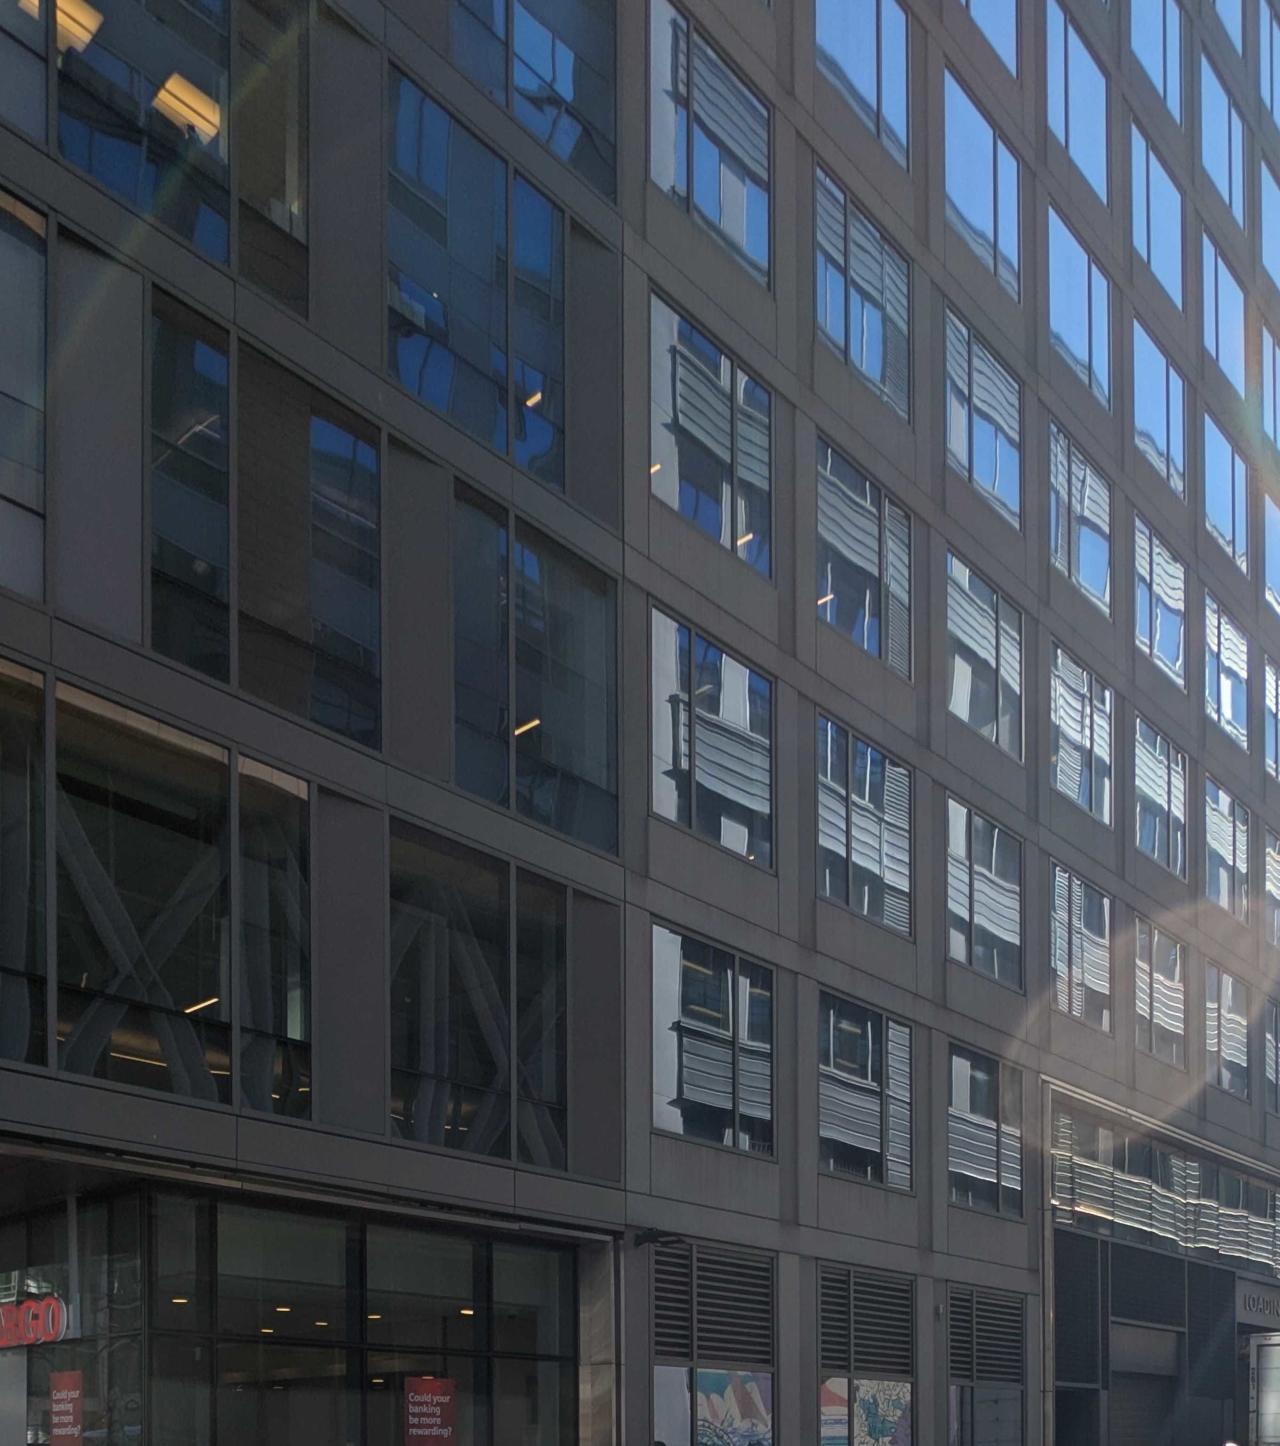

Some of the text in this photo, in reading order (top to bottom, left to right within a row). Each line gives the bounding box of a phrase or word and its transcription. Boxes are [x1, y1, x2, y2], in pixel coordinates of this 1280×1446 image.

[52, 1390, 80, 1401] Could your
[409, 1393, 451, 1405] Could your
[52, 1401, 73, 1413] banking
[409, 1404, 440, 1416] banking
[52, 1415, 73, 1423] be more
[409, 1415, 441, 1425] be more
[52, 1425, 81, 1438] rewarding?
[409, 1427, 452, 1438] rewarding?
